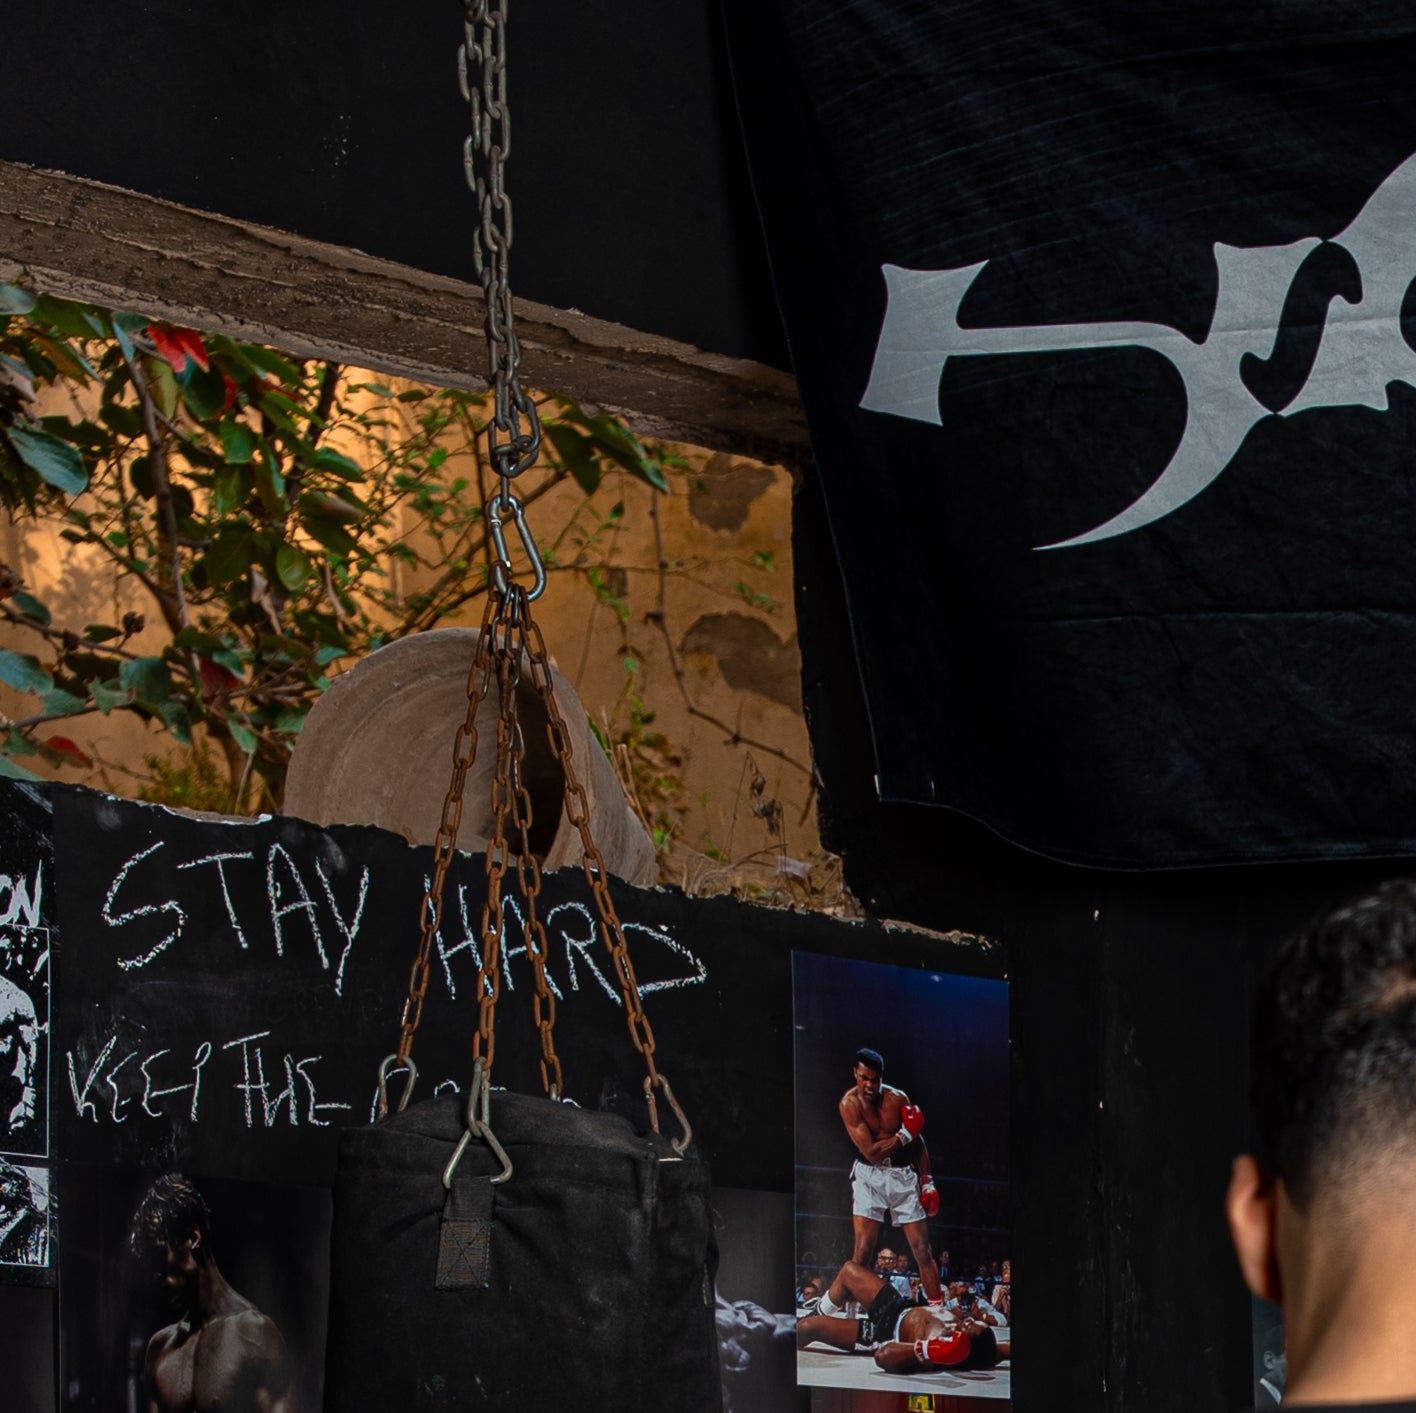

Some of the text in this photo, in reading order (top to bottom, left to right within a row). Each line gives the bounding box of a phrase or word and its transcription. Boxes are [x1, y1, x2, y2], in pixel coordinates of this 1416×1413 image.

[101, 841, 708, 1006] STAY HARD
[66, 1034, 211, 1124] KEEP
[221, 1031, 352, 1128] THE
